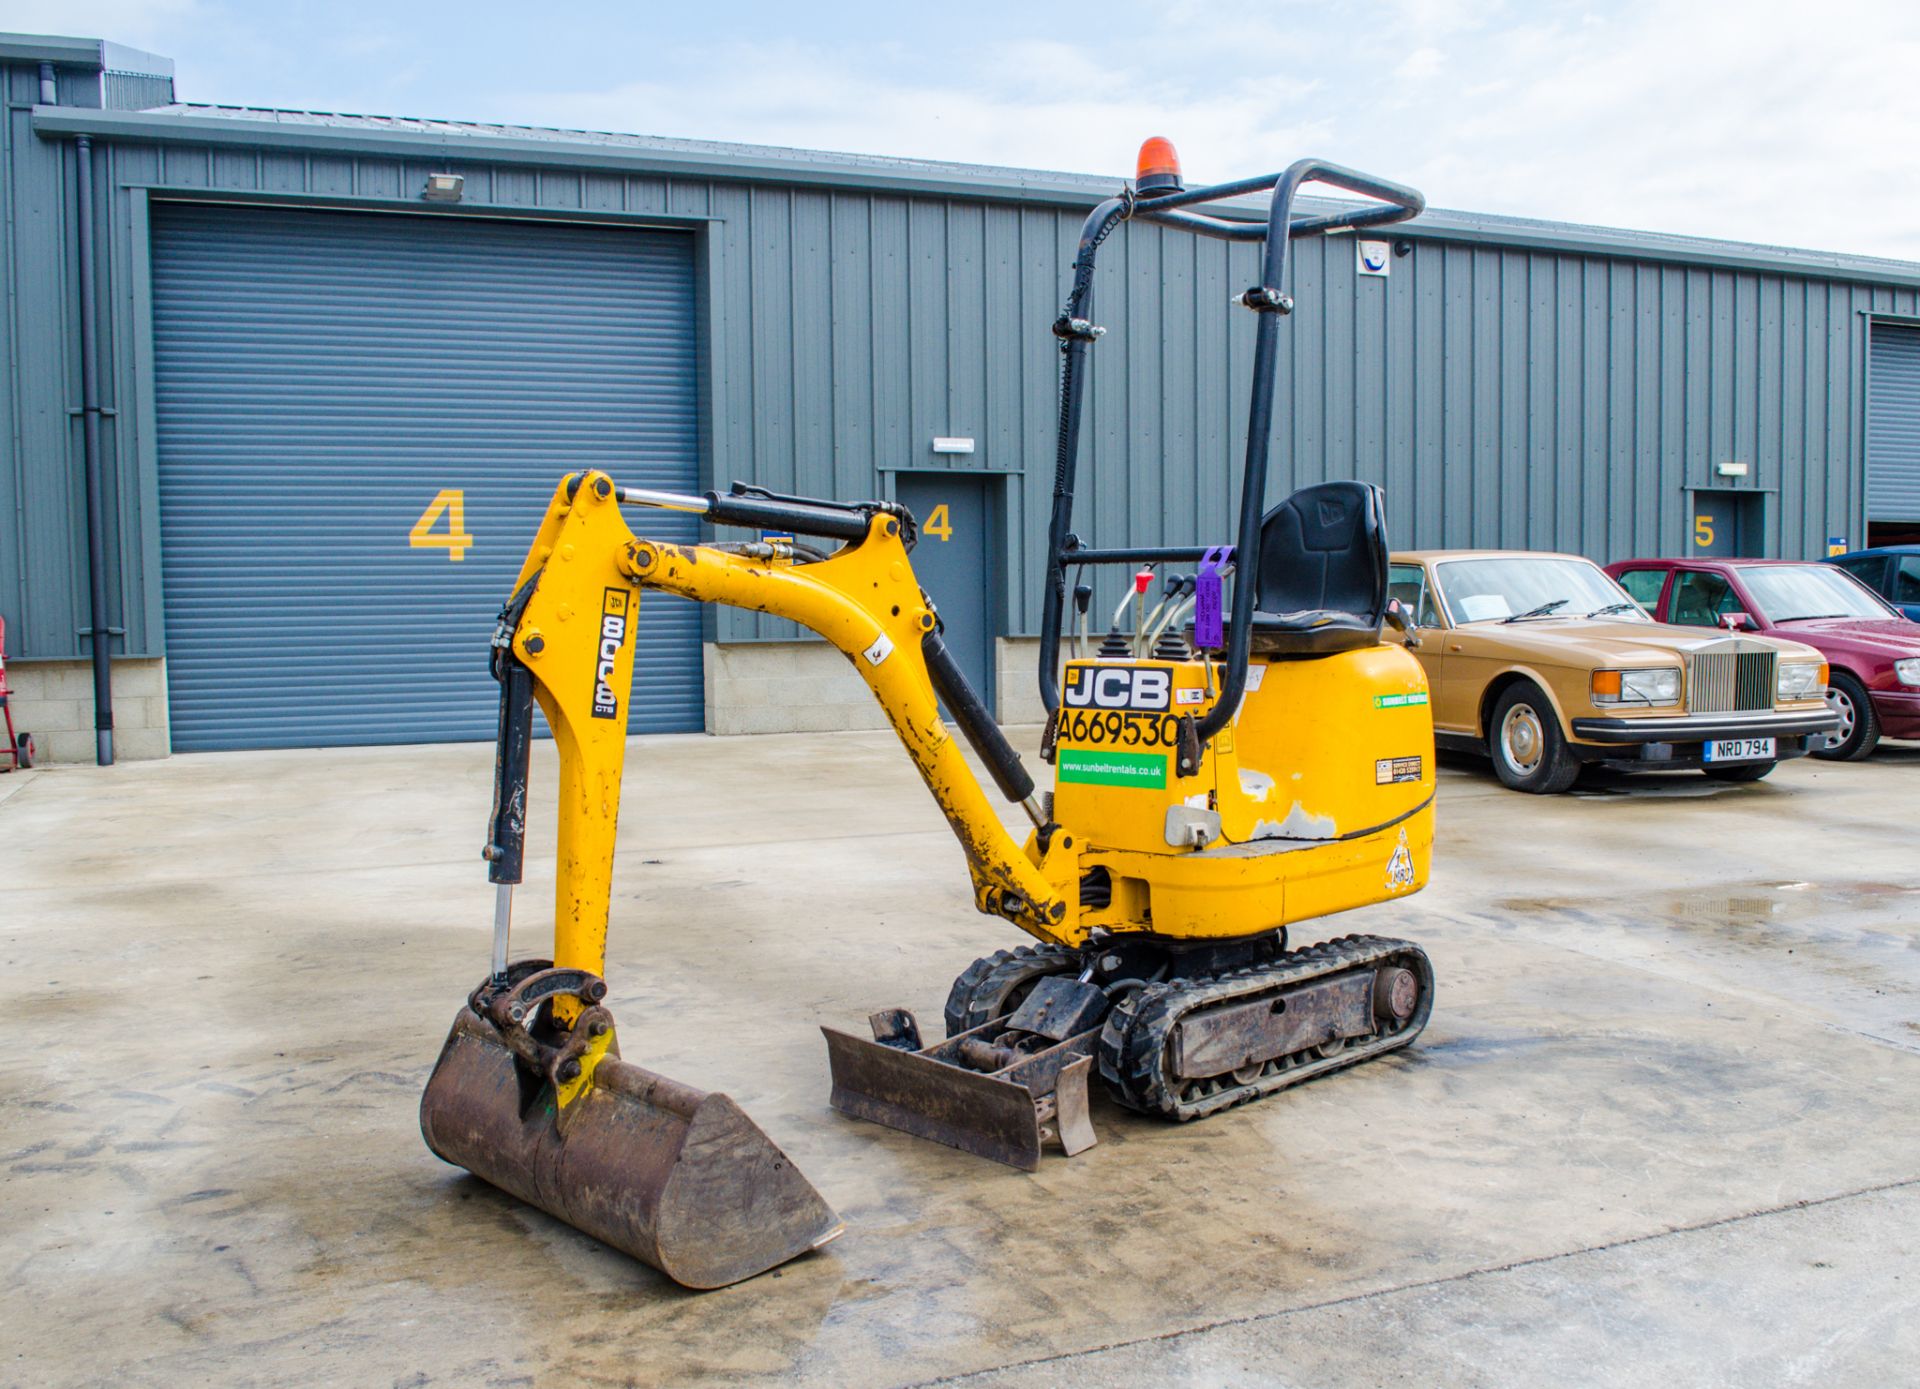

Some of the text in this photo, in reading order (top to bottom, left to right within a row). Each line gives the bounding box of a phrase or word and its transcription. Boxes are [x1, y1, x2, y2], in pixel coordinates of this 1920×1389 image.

[408, 489, 474, 562] 4
[922, 503, 953, 542] 4
[1695, 515, 1715, 547] 5
[1065, 668, 1170, 709] JCB
[1057, 710, 1181, 747] A669530
[1717, 740, 1769, 757] NRD 794
[1062, 761, 1162, 777] www.sunbeltrentals.co.uk
